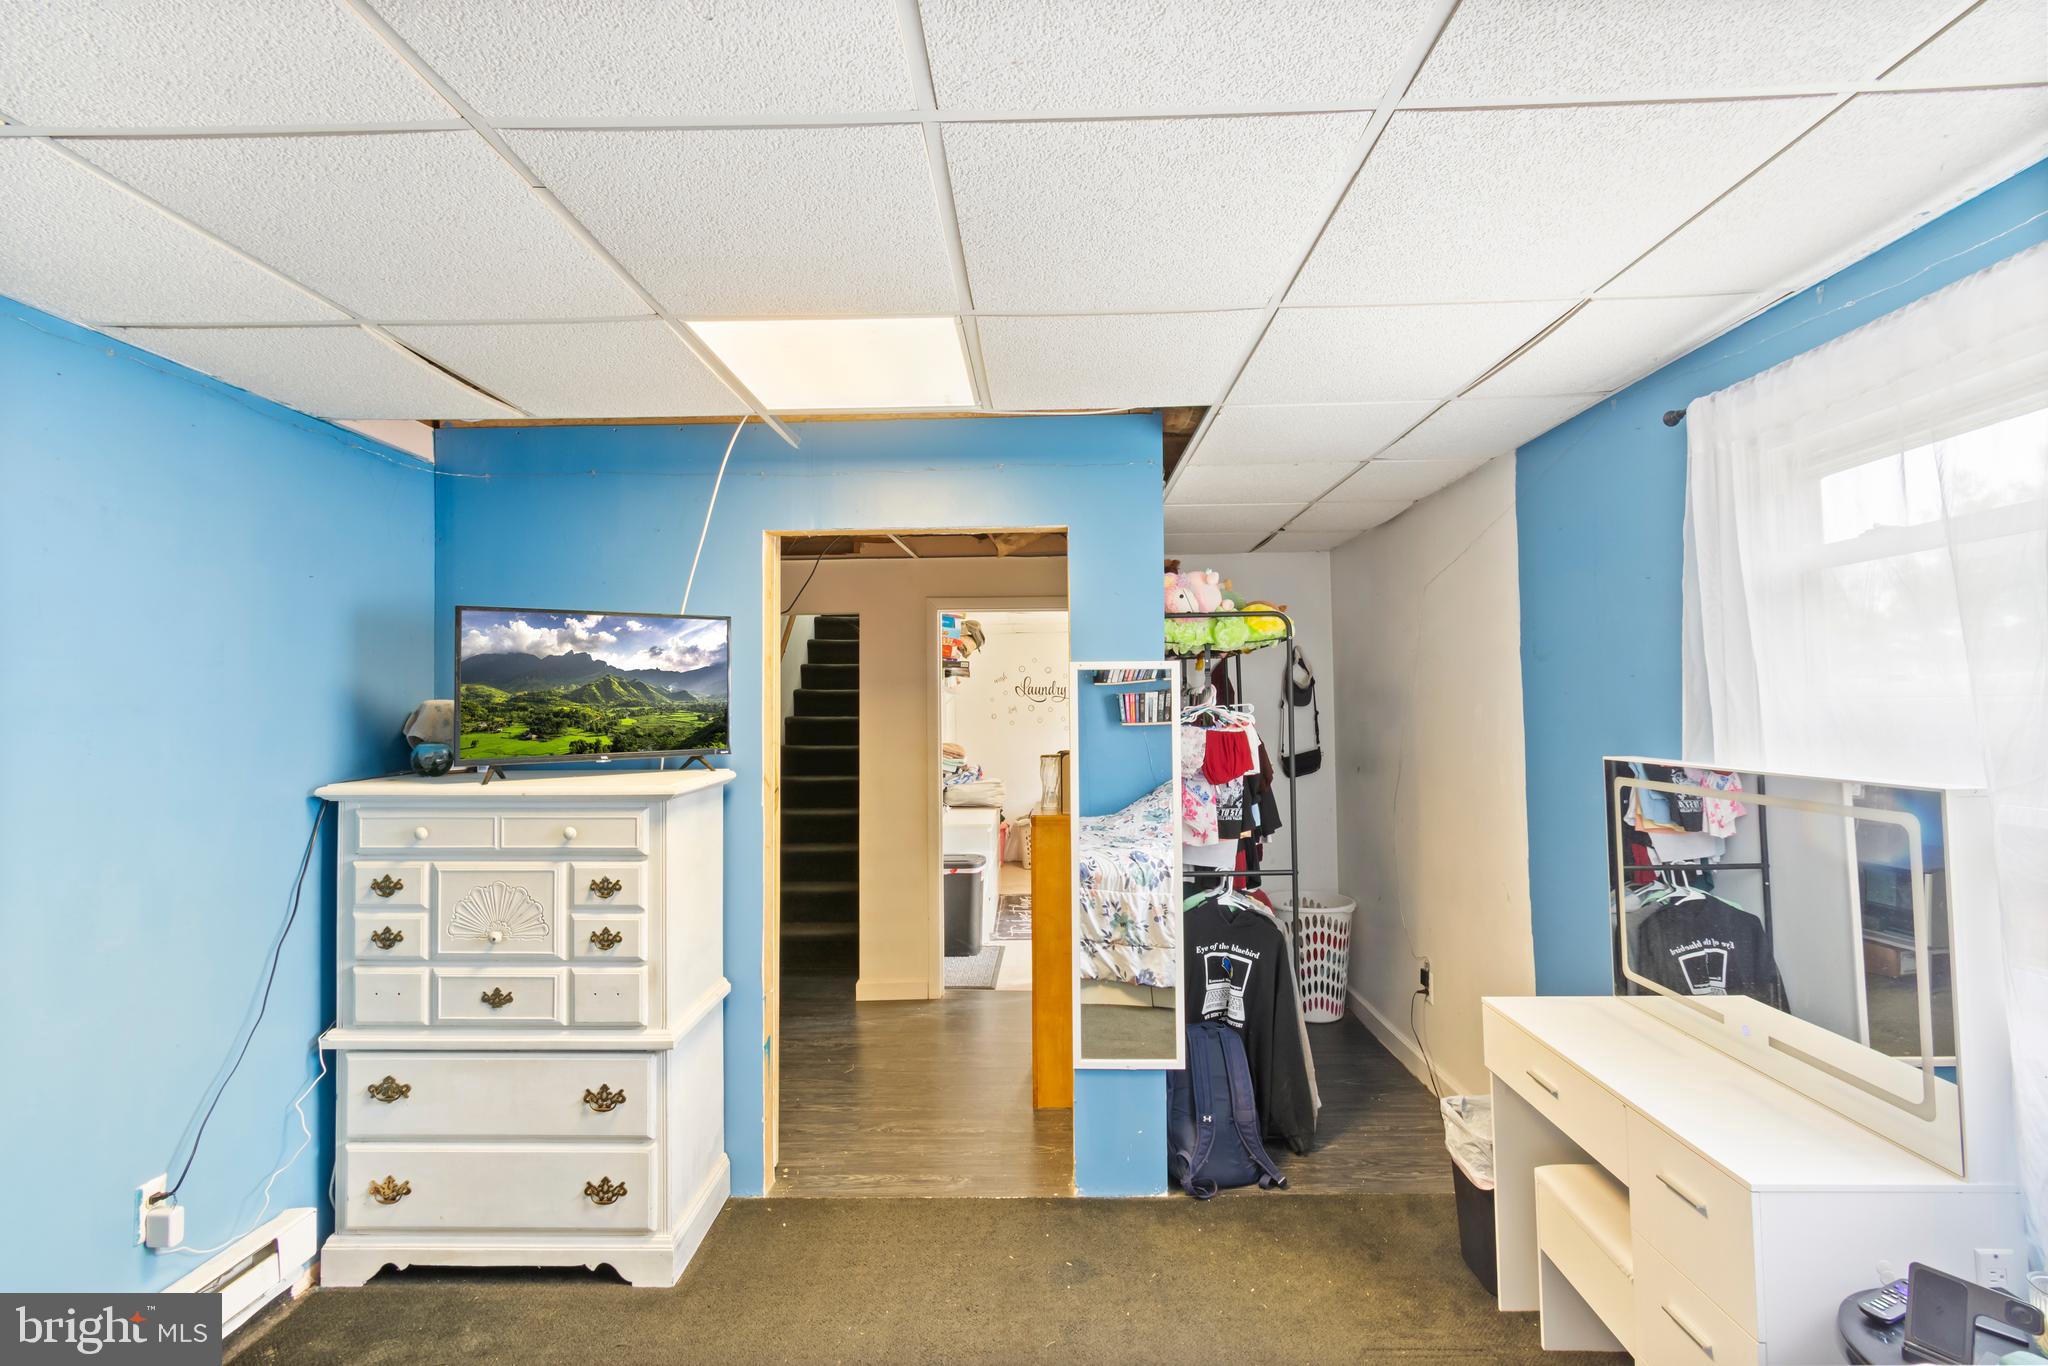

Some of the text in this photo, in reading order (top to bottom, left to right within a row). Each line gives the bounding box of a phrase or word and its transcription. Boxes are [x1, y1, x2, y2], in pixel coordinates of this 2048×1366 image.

[1015, 676, 1069, 703] Laundry
[1196, 942, 1260, 959] Eye of the bluebird
